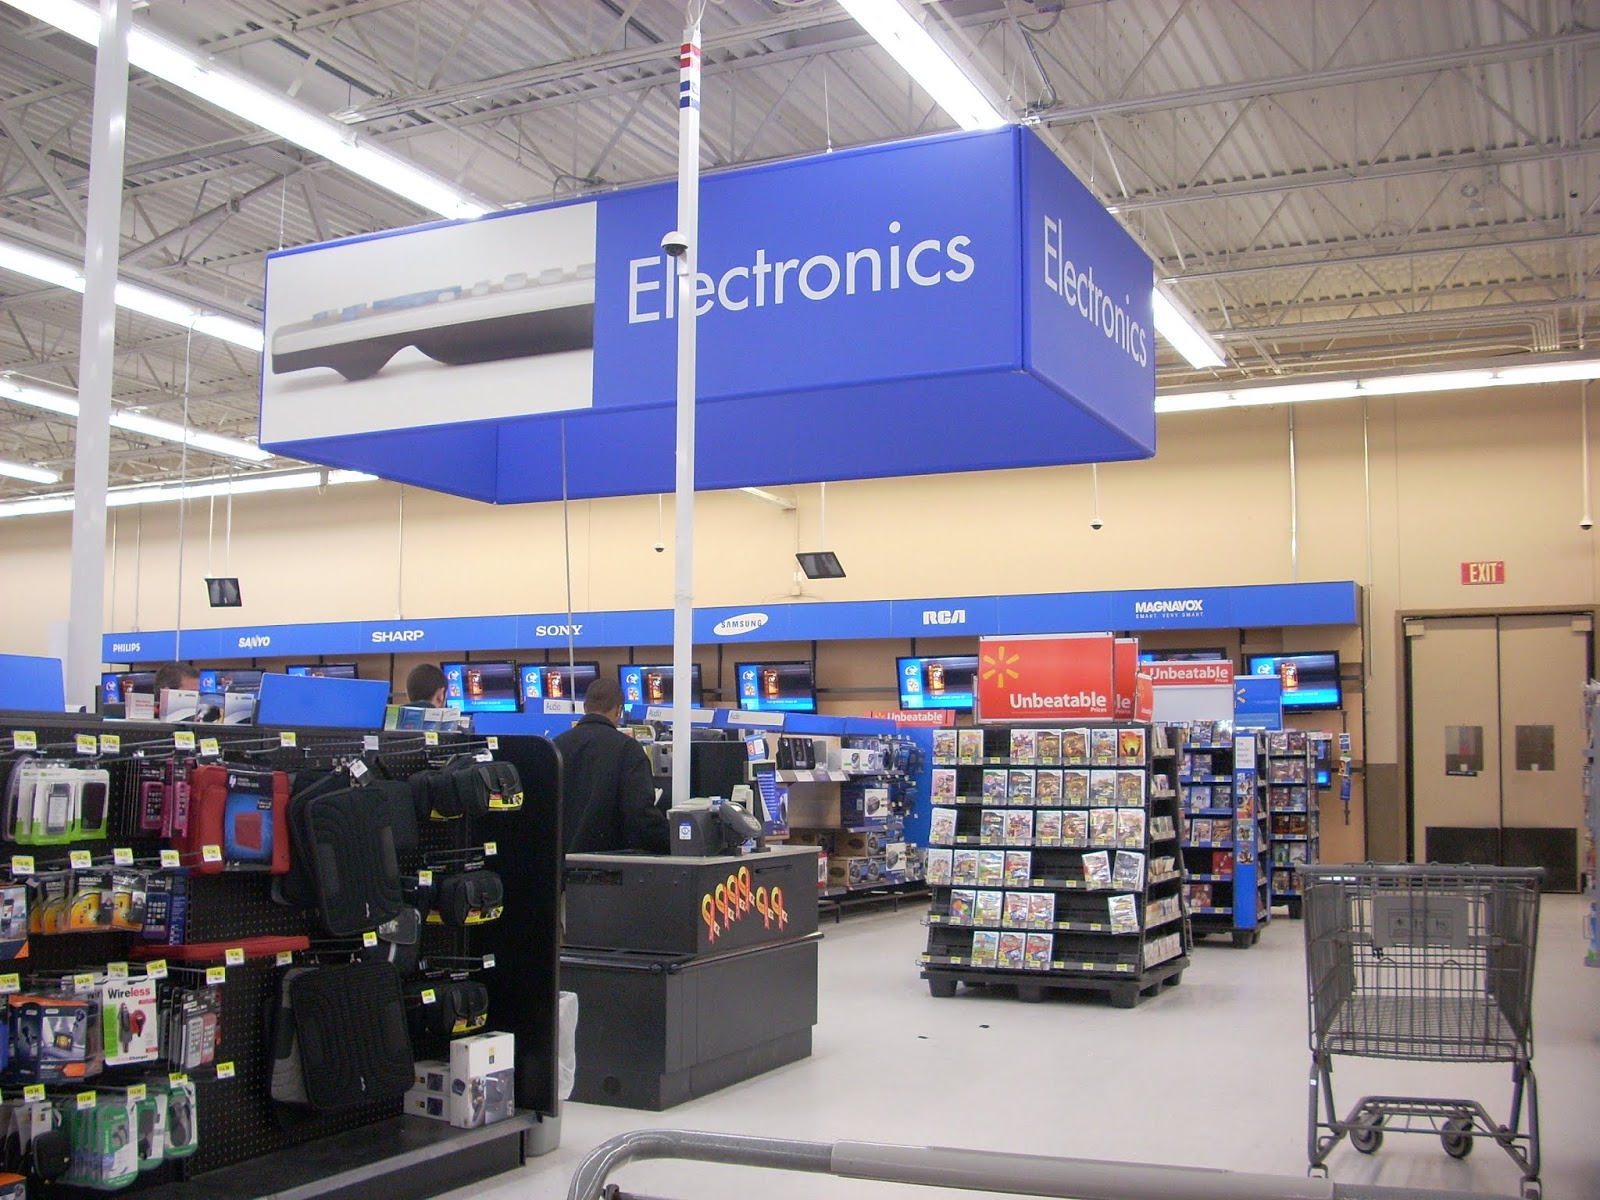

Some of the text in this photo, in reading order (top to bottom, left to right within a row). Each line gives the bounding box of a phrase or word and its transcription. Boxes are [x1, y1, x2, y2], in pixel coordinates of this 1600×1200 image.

[627, 220, 976, 325] Electronics
[1043, 214, 1147, 368] Electronics
[1470, 563, 1497, 583] EXIT
[1135, 600, 1203, 613] MAGNAVOX
[720, 619, 762, 629] SAMSUNG
[922, 610, 966, 625] RCA
[371, 630, 424, 643] SHARP
[536, 624, 583, 637] SONY
[112, 643, 141, 653] PHILIPS
[238, 636, 270, 648] SANYO
[1151, 666, 1229, 680] Unbeatable
[1009, 691, 1107, 708] Unbeatable
[887, 711, 943, 722] Unbeatable
[107, 986, 151, 999] Wireless
